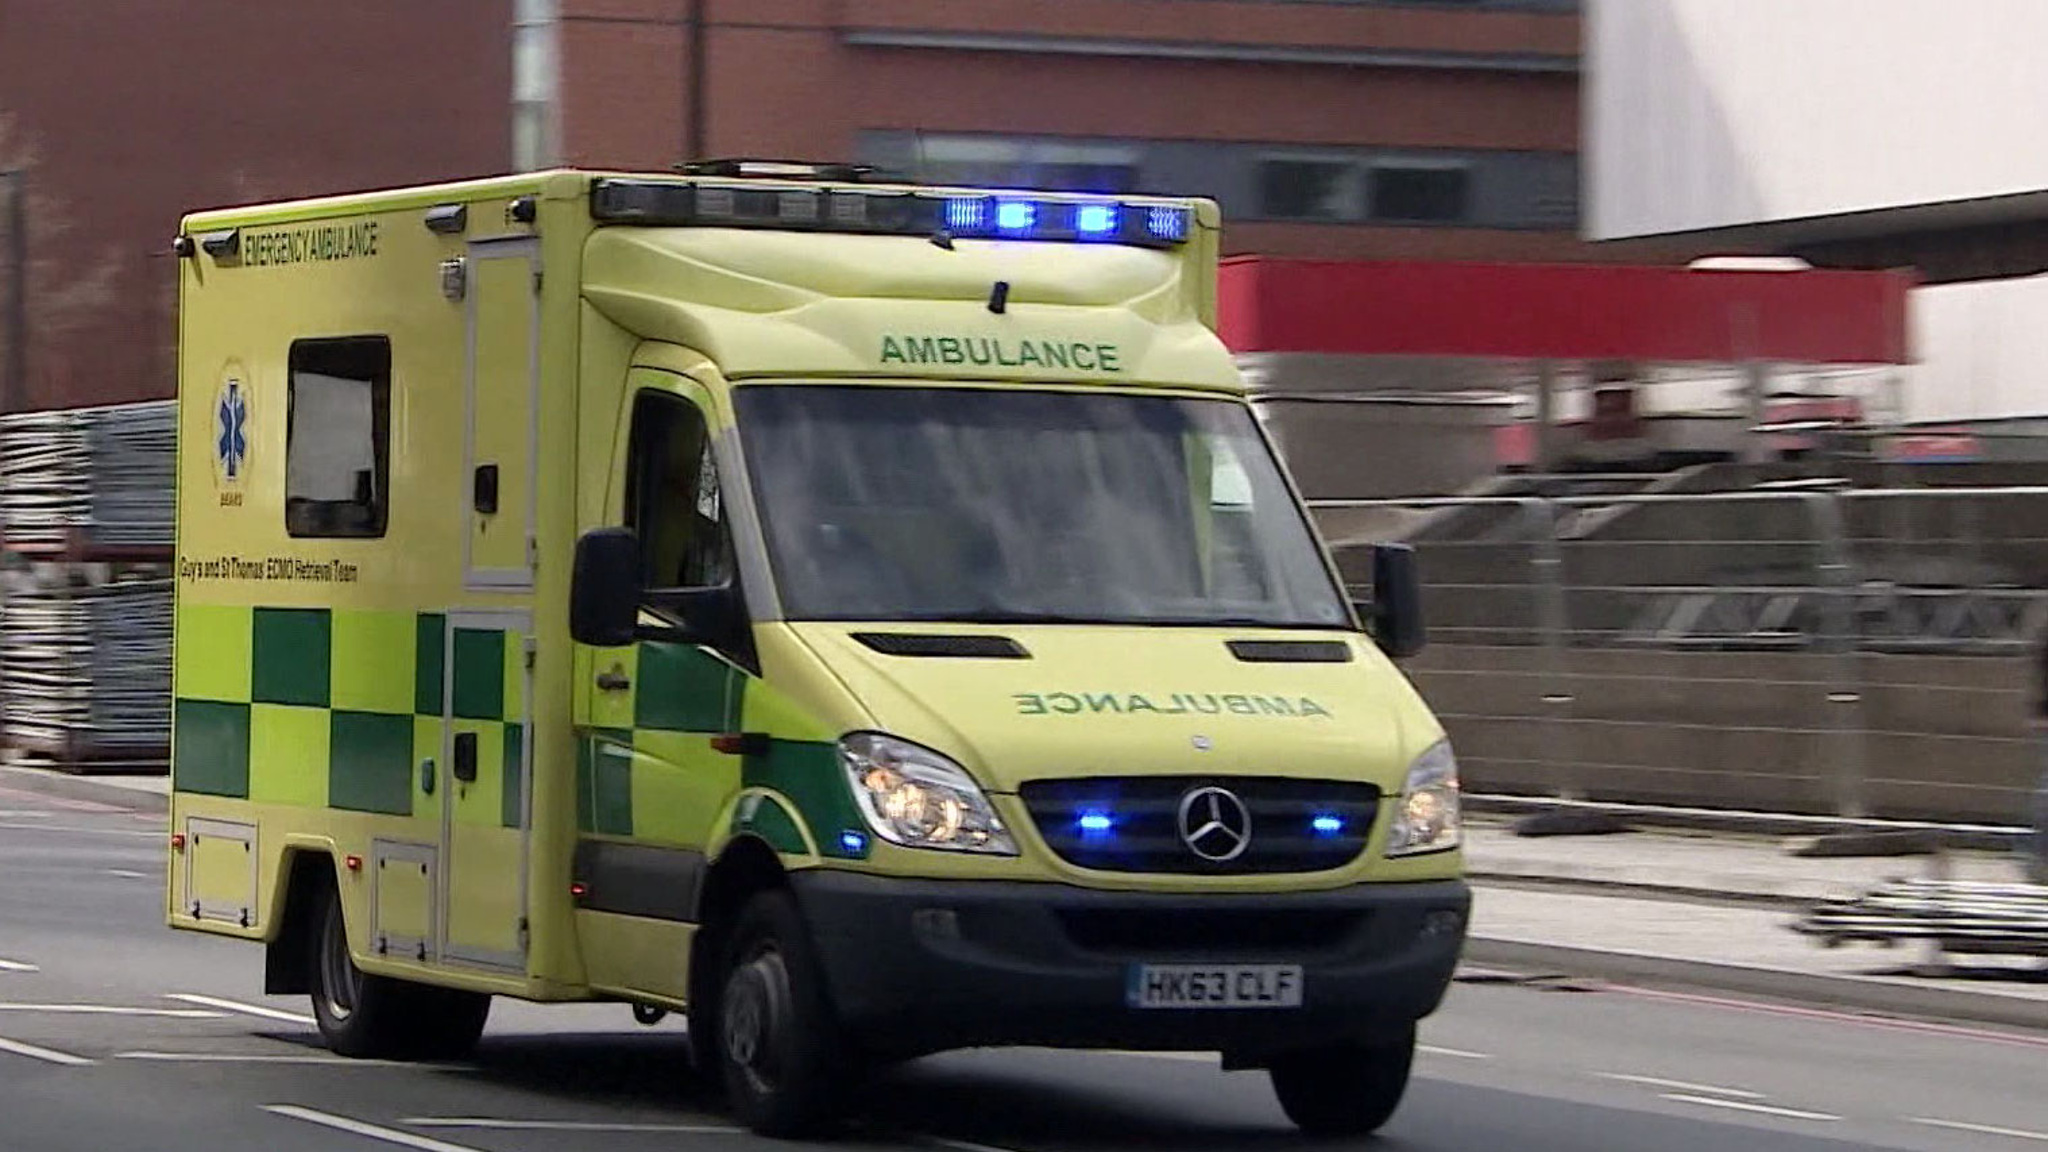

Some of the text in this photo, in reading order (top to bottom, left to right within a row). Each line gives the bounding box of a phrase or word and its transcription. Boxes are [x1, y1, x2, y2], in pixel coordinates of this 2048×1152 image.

[245, 221, 378, 266] EMERGENCY AMBULANCE
[880, 335, 1120, 372] AMBULANCE
[204, 559, 219, 579] and
[267, 558, 293, 580] ECMO
[332, 559, 357, 583] Team
[1147, 971, 1294, 1002] HK63 CLF
